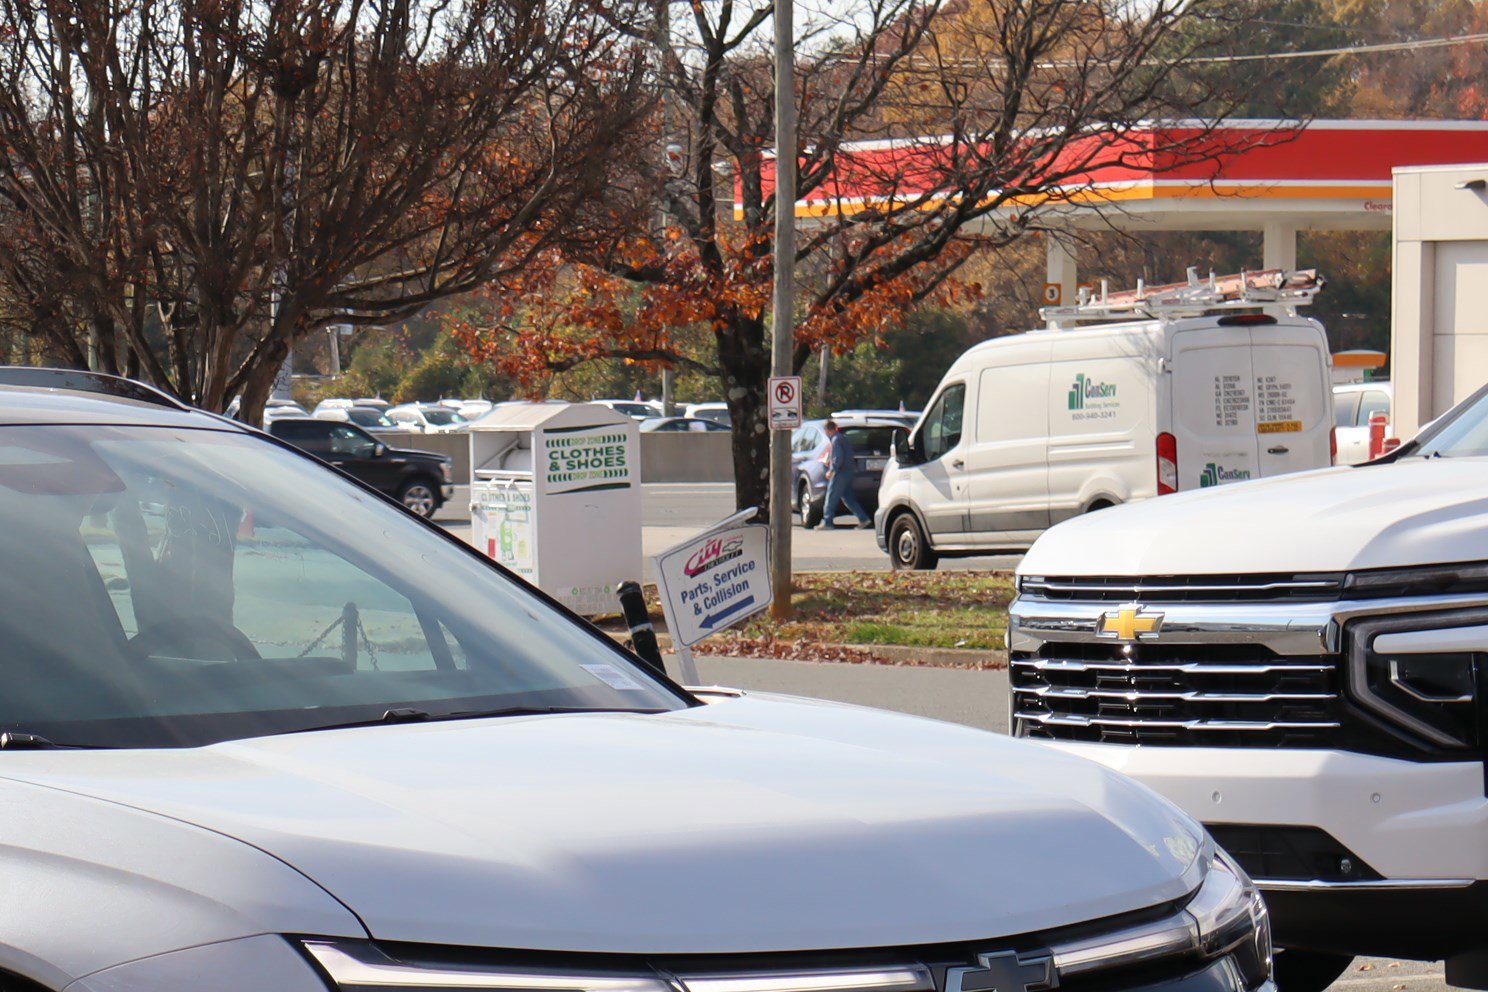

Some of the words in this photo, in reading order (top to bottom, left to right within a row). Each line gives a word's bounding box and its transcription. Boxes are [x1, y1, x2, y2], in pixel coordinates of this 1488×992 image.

[1084, 378, 1117, 399] ConServ
[548, 445, 626, 460] CLOTHES
[549, 461, 560, 472] &
[566, 456, 626, 471] SHOES
[1217, 466, 1251, 481] ConServ
[684, 538, 723, 576] City
[680, 582, 713, 605] Parts,
[713, 560, 756, 587] Service
[693, 603, 703, 616] &
[704, 580, 750, 610] Collision
